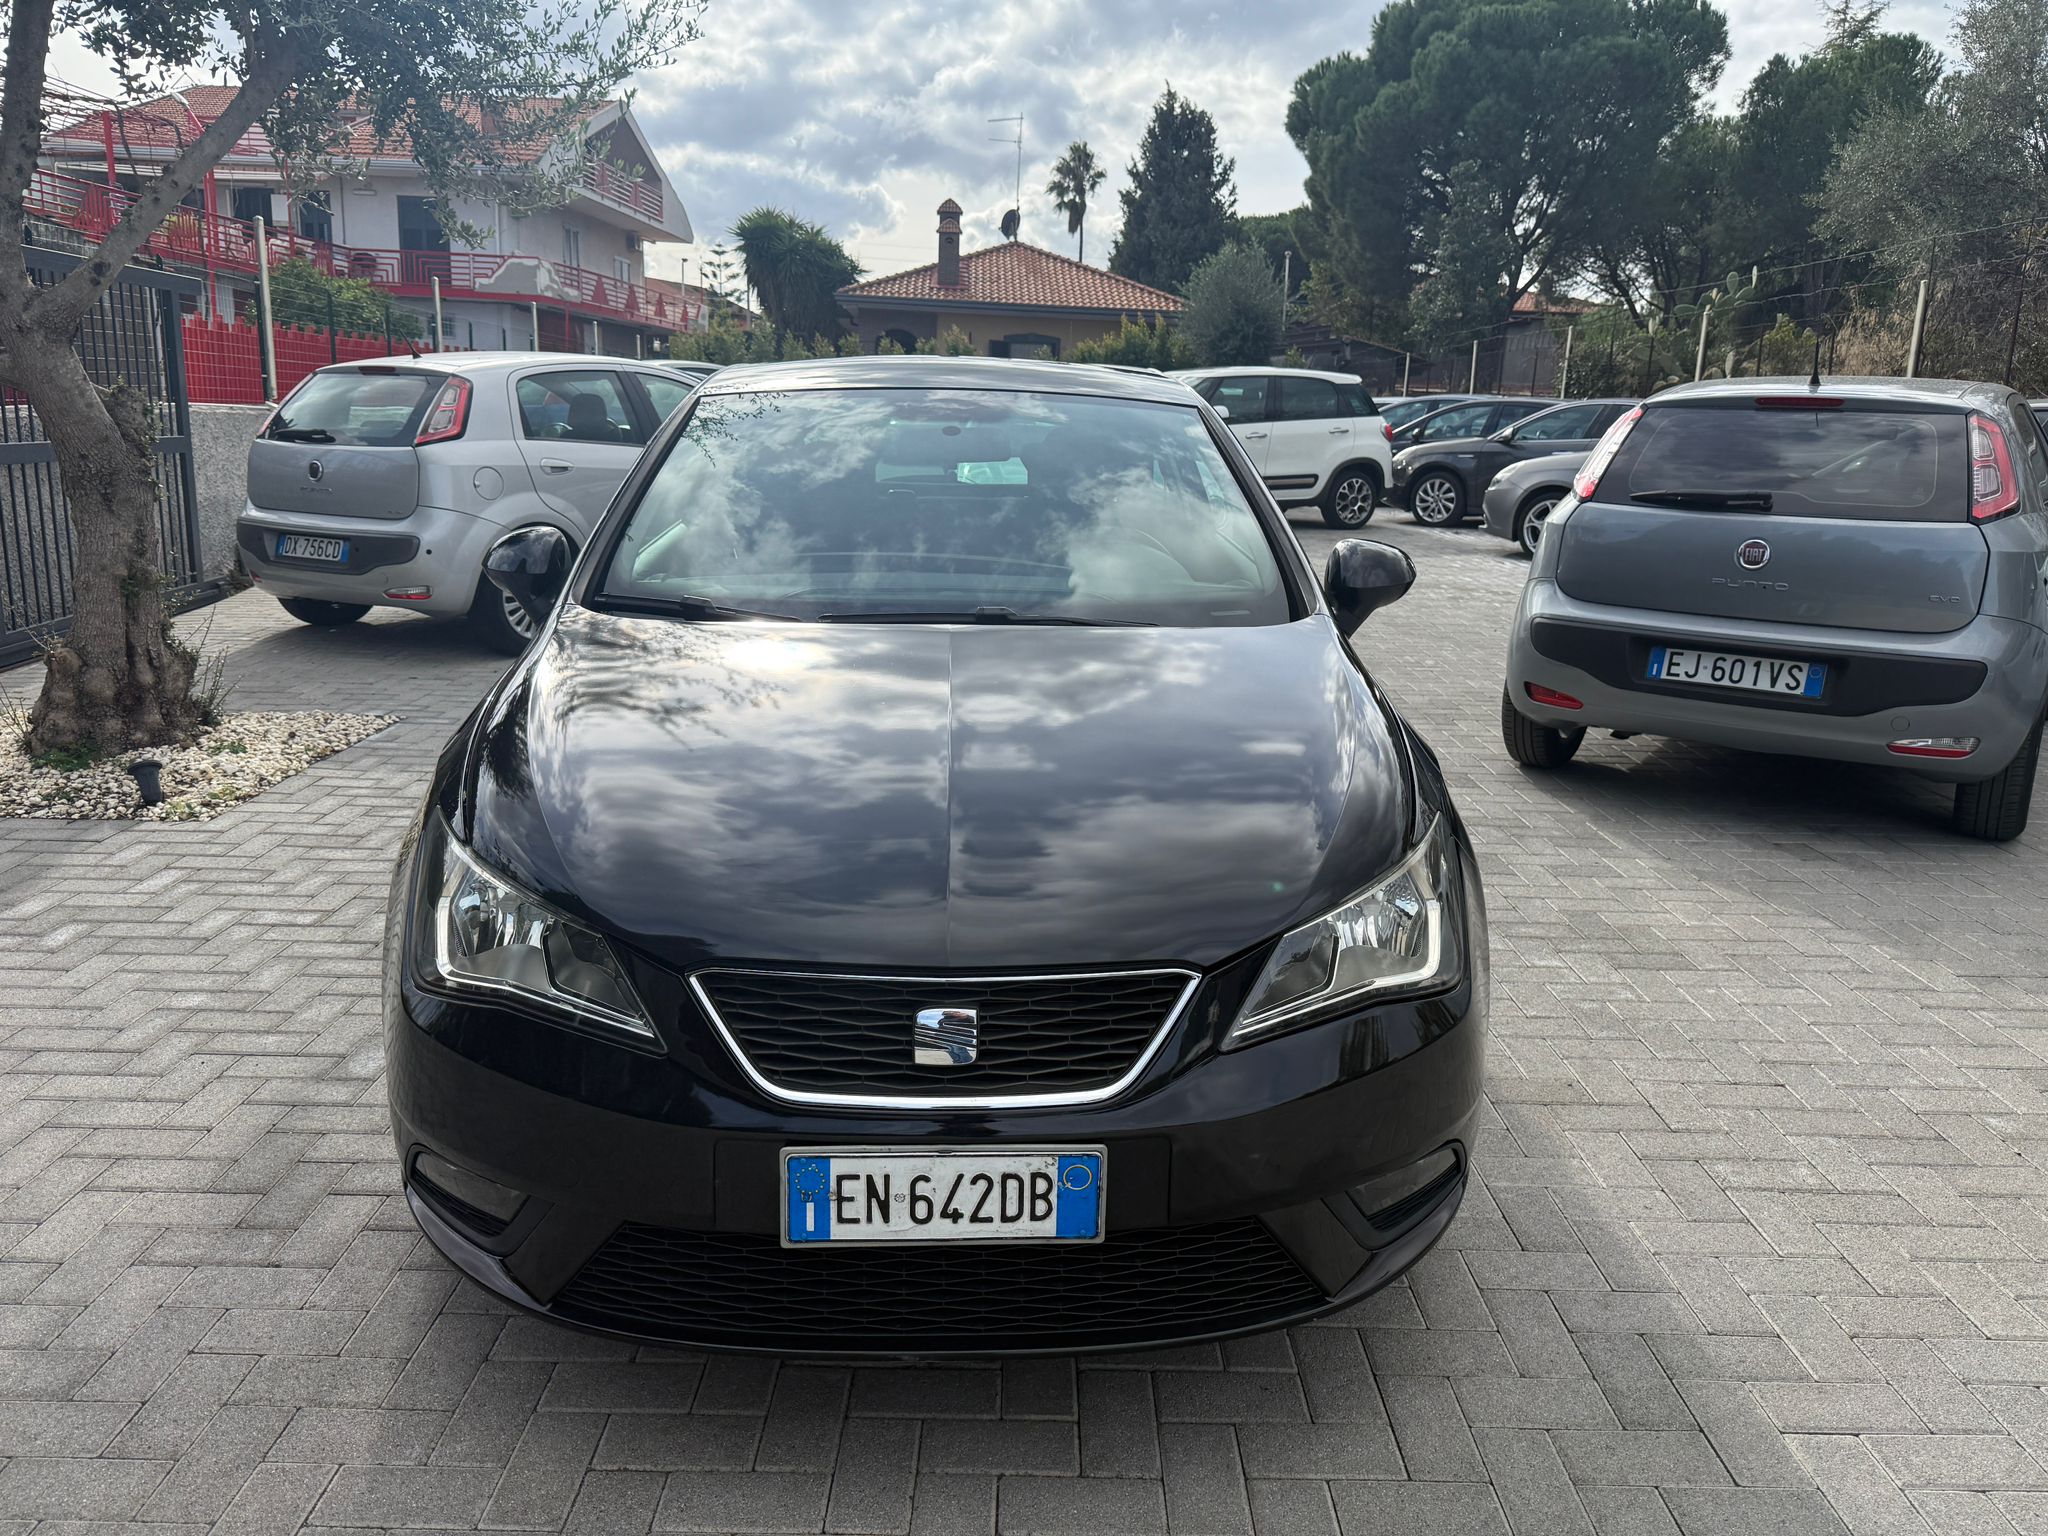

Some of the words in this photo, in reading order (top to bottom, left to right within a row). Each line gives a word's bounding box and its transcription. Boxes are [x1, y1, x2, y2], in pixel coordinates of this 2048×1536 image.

[284, 536, 299, 556] DX
[301, 538, 341, 559] 756CD
[1744, 547, 1765, 562] FIAT
[1665, 651, 1702, 679] EJ
[1710, 656, 1803, 691] 601VS
[836, 1173, 891, 1224] EN
[909, 1172, 1054, 1224] 642DB
